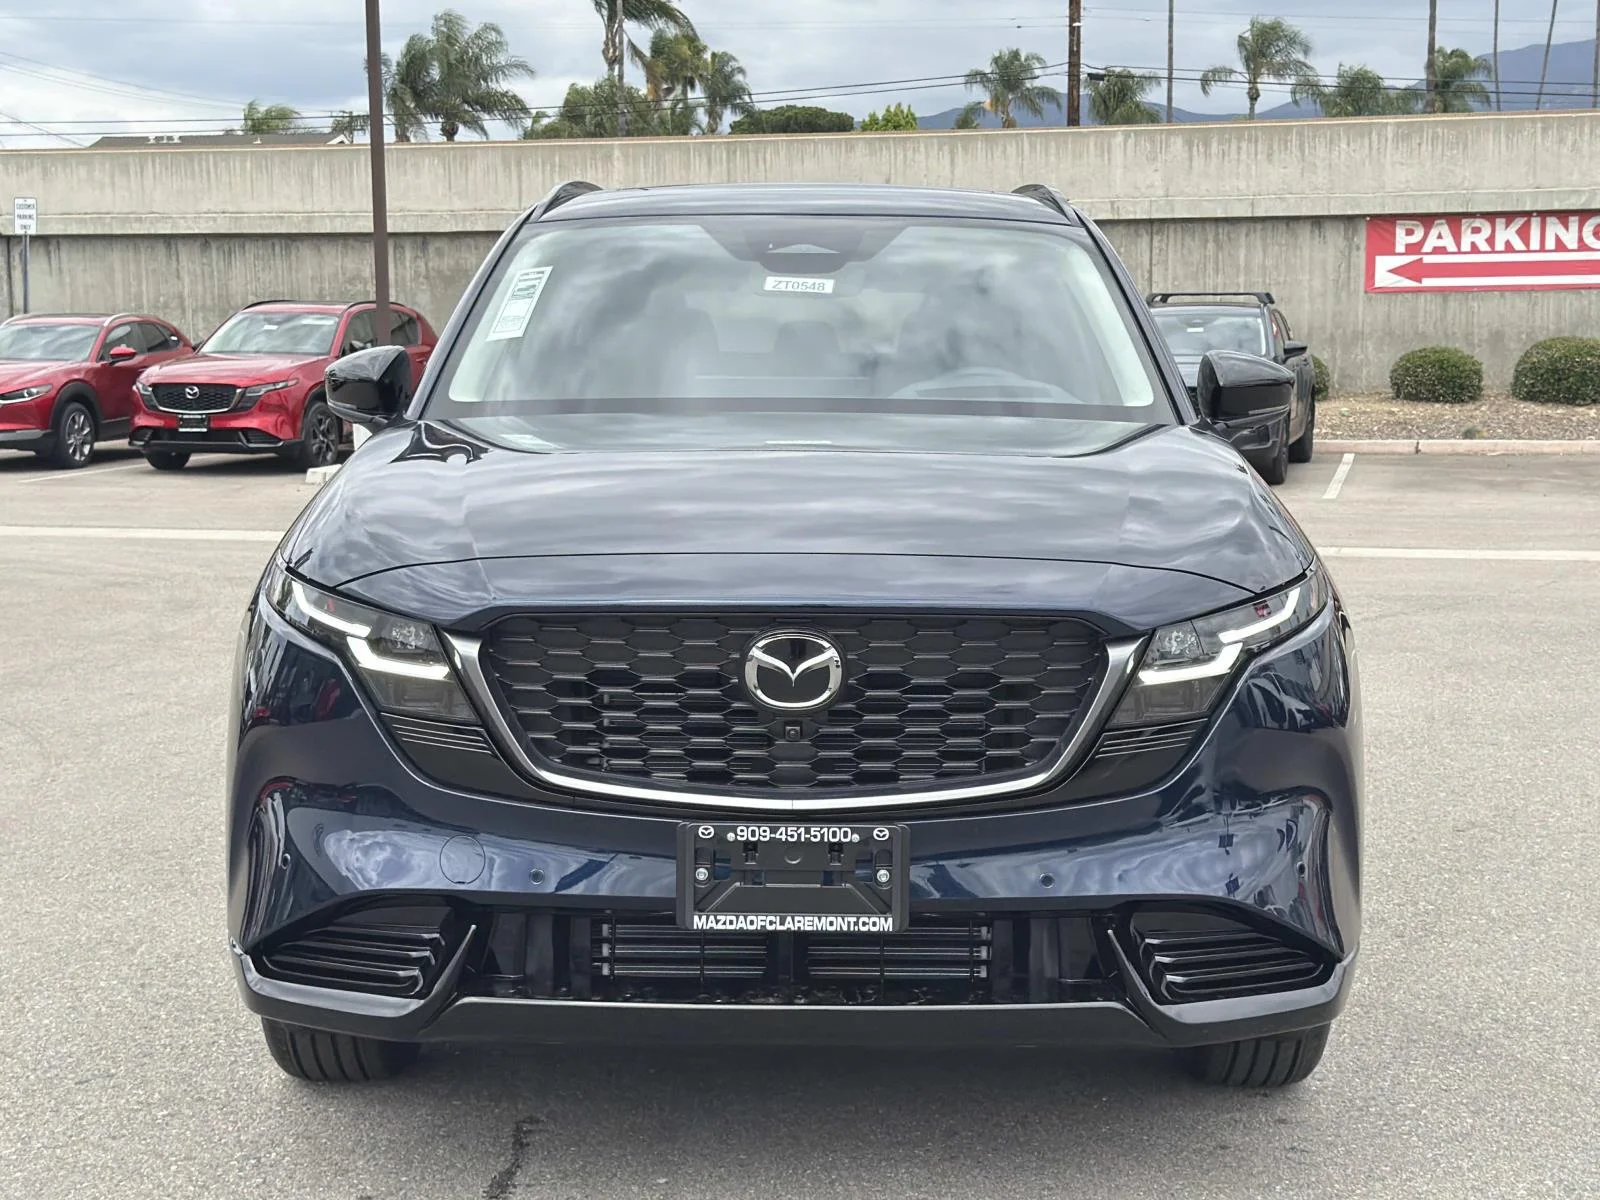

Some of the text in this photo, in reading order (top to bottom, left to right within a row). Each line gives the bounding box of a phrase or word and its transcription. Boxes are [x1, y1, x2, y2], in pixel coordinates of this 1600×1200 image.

[772, 280, 826, 291] ZT0548
[736, 826, 852, 842] 909-451-5100
[693, 915, 893, 932] MAZDAOFCLAREMONT.COM
